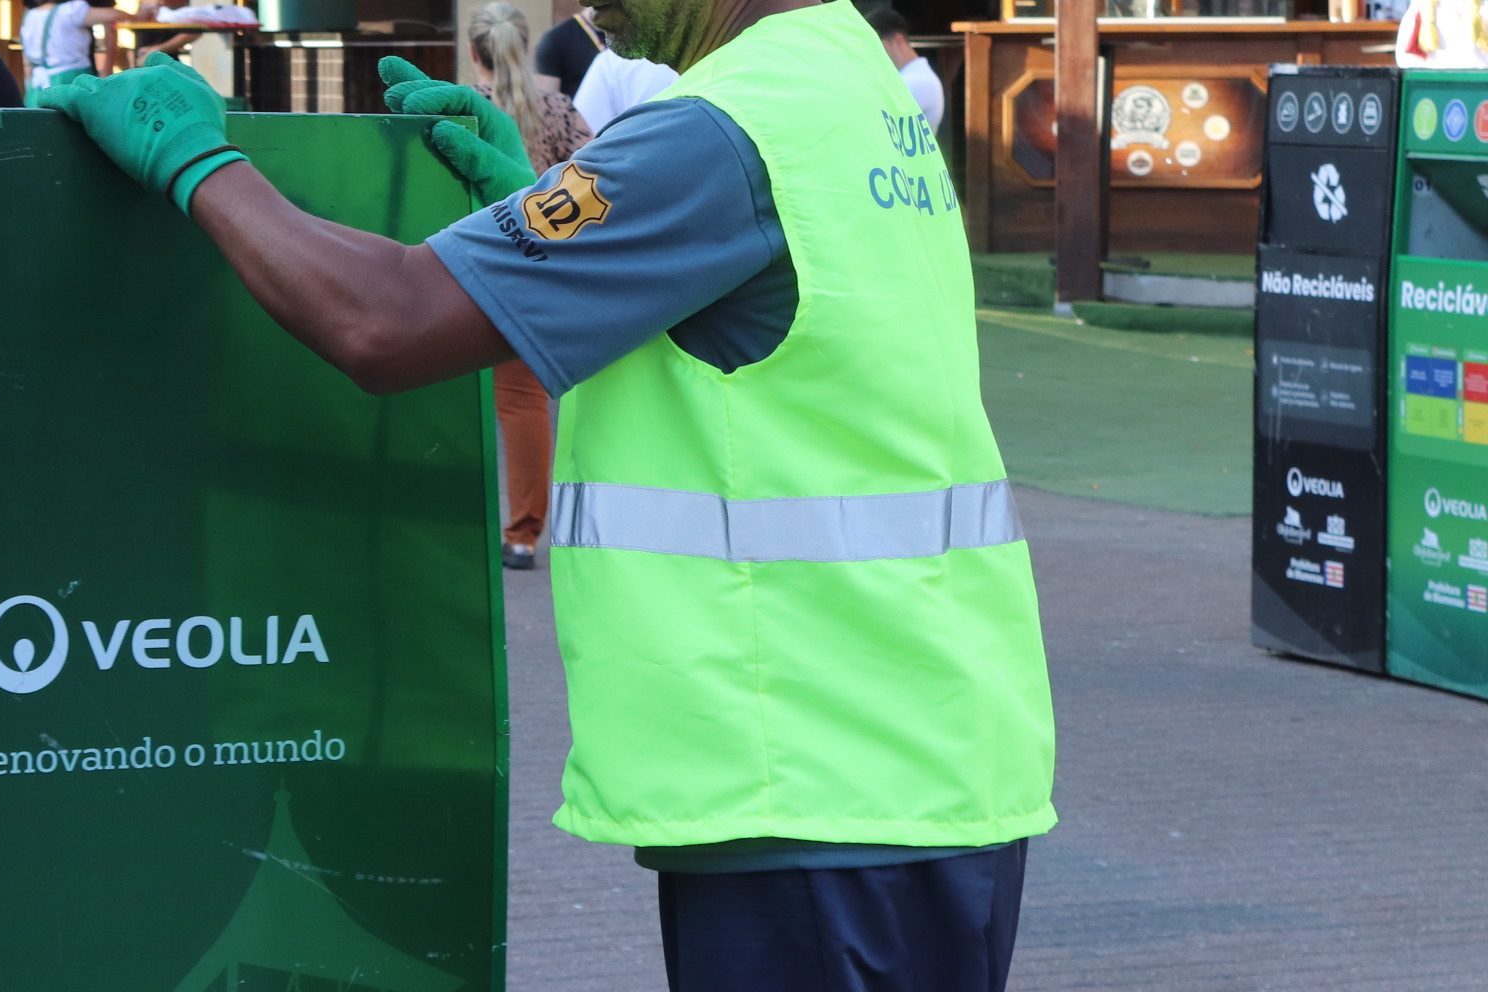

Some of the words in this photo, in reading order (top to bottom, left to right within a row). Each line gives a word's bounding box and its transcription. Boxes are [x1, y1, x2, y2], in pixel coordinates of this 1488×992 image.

[1262, 270, 1290, 295] Não
[1292, 272, 1375, 303] Recicláveis
[1401, 281, 1488, 316] Recicláv
[1302, 476, 1345, 499] VEOLIA
[1442, 497, 1488, 521] VEOLIA
[81, 614, 329, 670] VEOLIA
[184, 742, 205, 766] o
[213, 731, 346, 766] mundo
